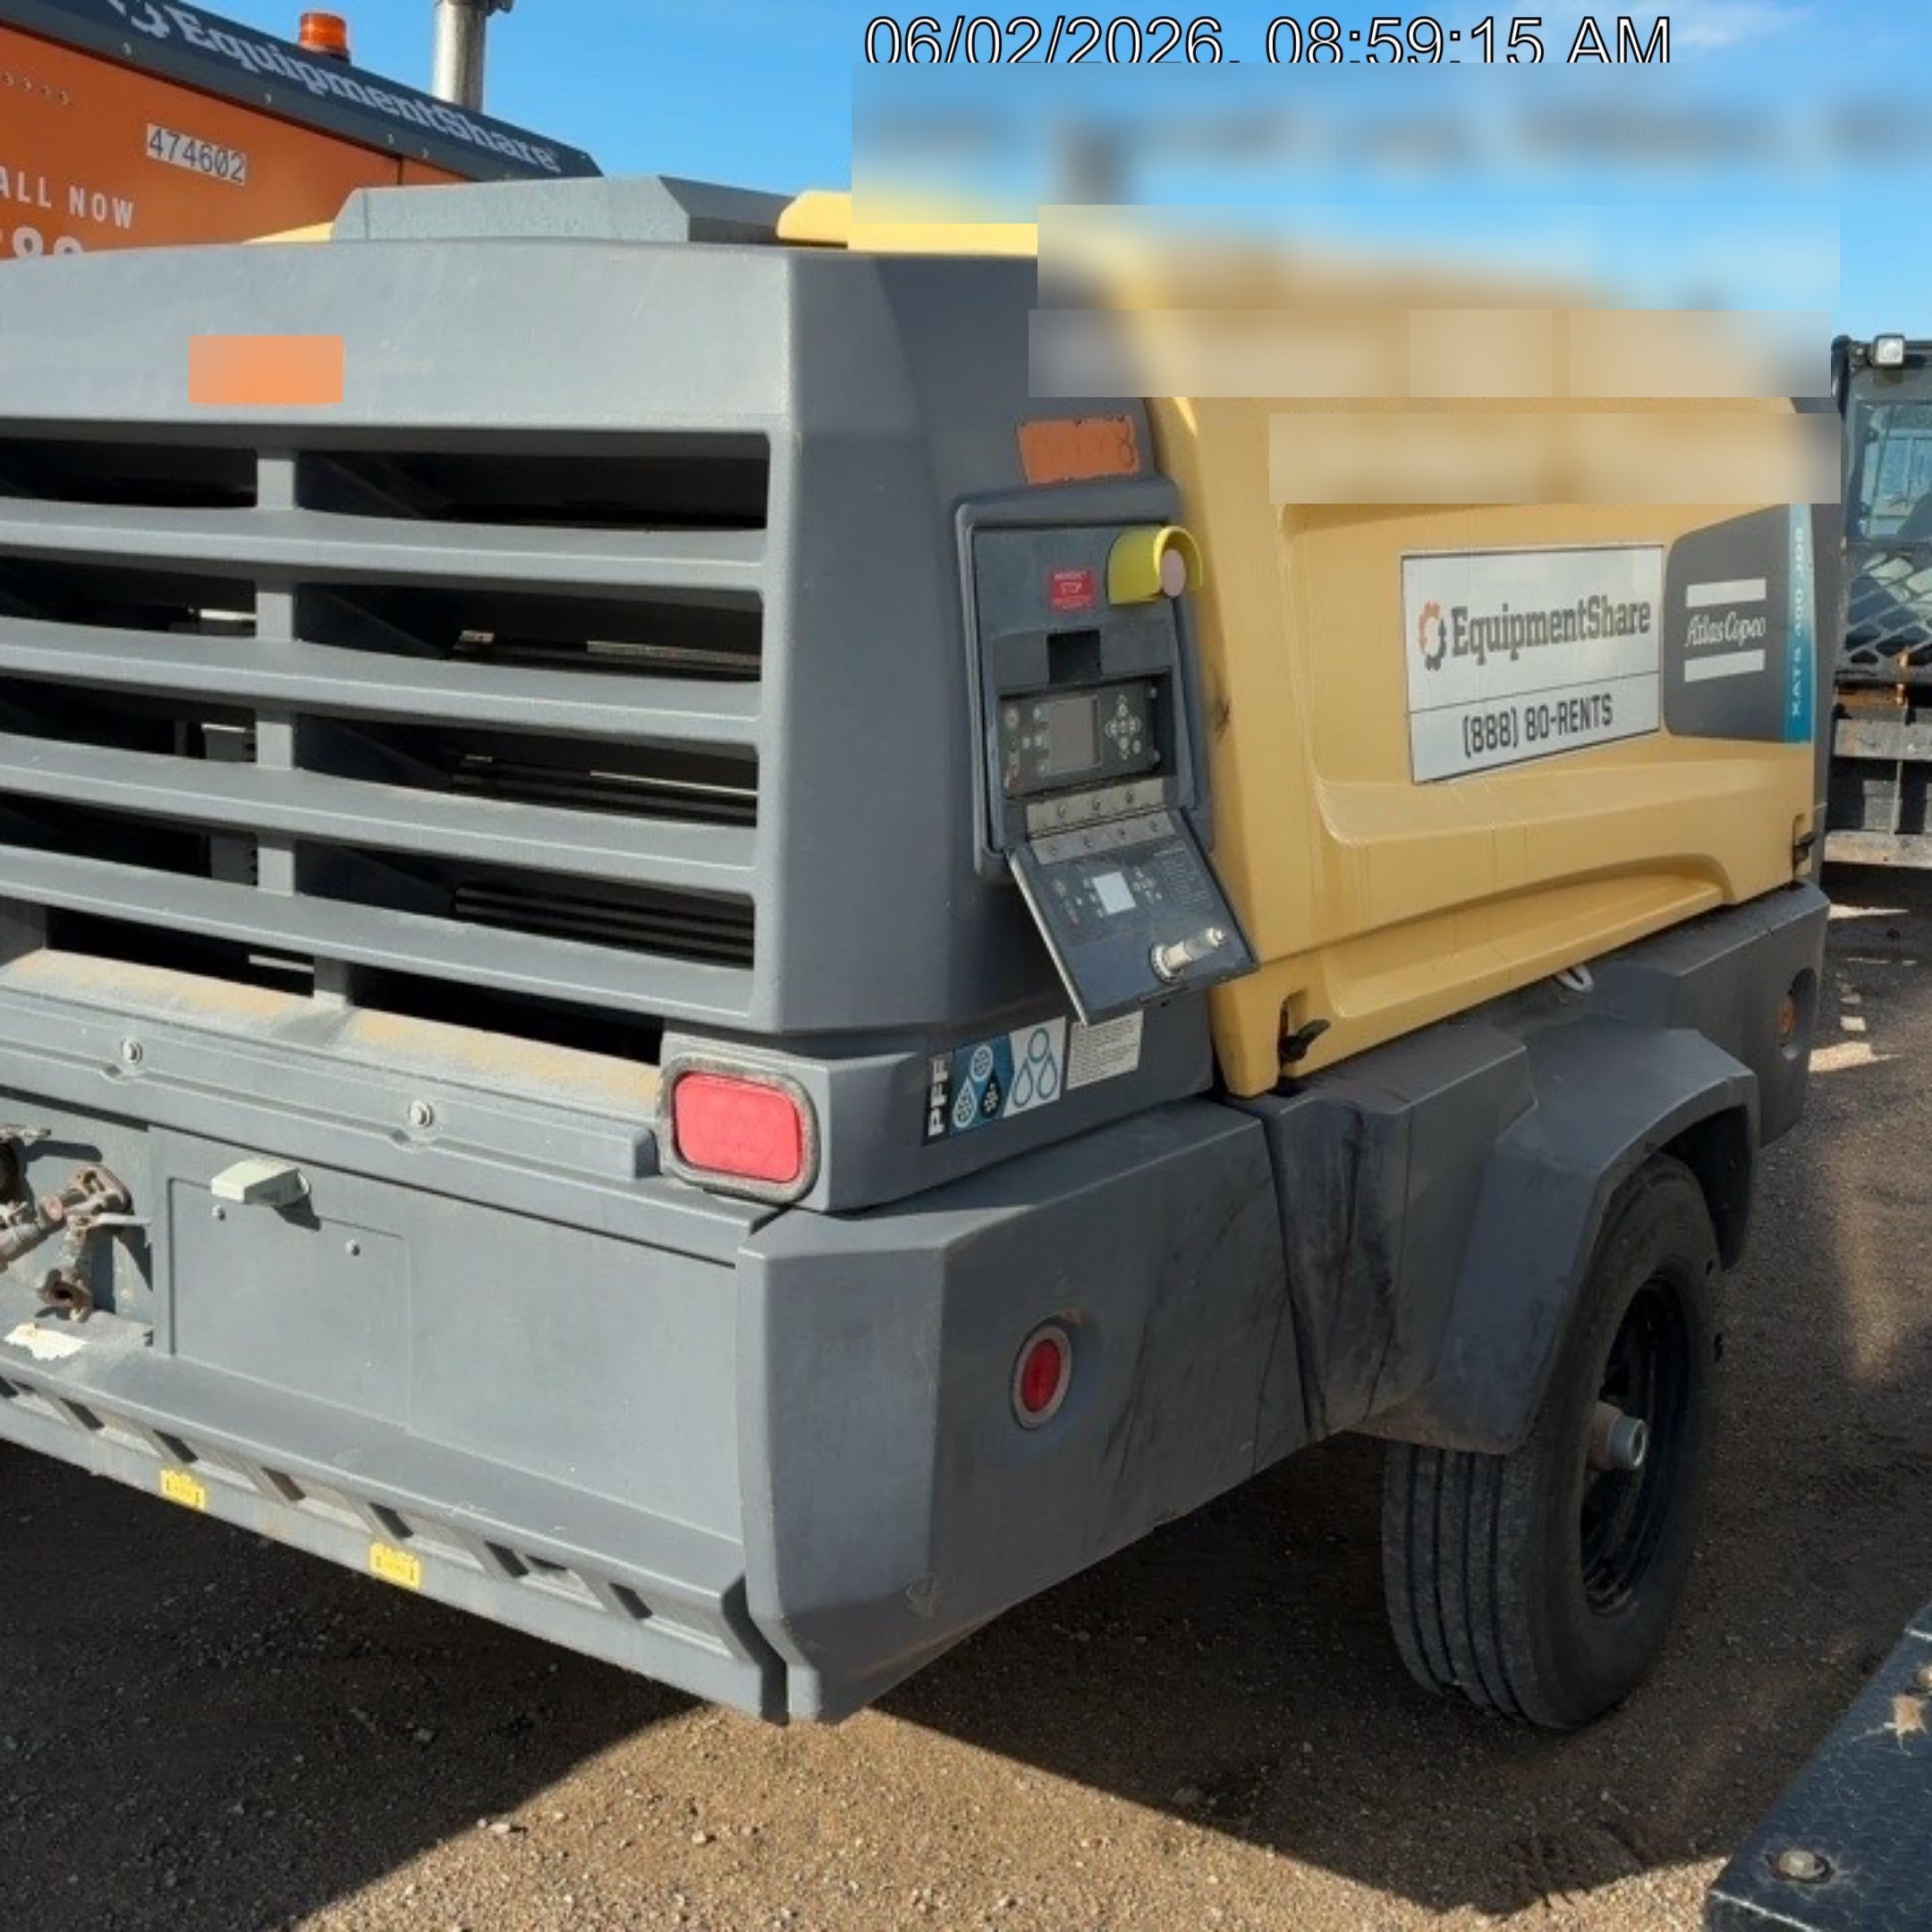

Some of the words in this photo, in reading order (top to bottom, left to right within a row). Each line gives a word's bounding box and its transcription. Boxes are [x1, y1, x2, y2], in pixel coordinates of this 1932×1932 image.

[164, 4, 562, 173] EquipmentShare
[148, 127, 245, 182] 474602
[69, 184, 133, 229] NOW
[1451, 594, 1651, 665] EquipmentShare
[1684, 614, 1724, 648] Atlas
[1724, 611, 1767, 648] Copco
[1462, 706, 1519, 758] (888)
[1524, 693, 1614, 741] 80-RENTS
